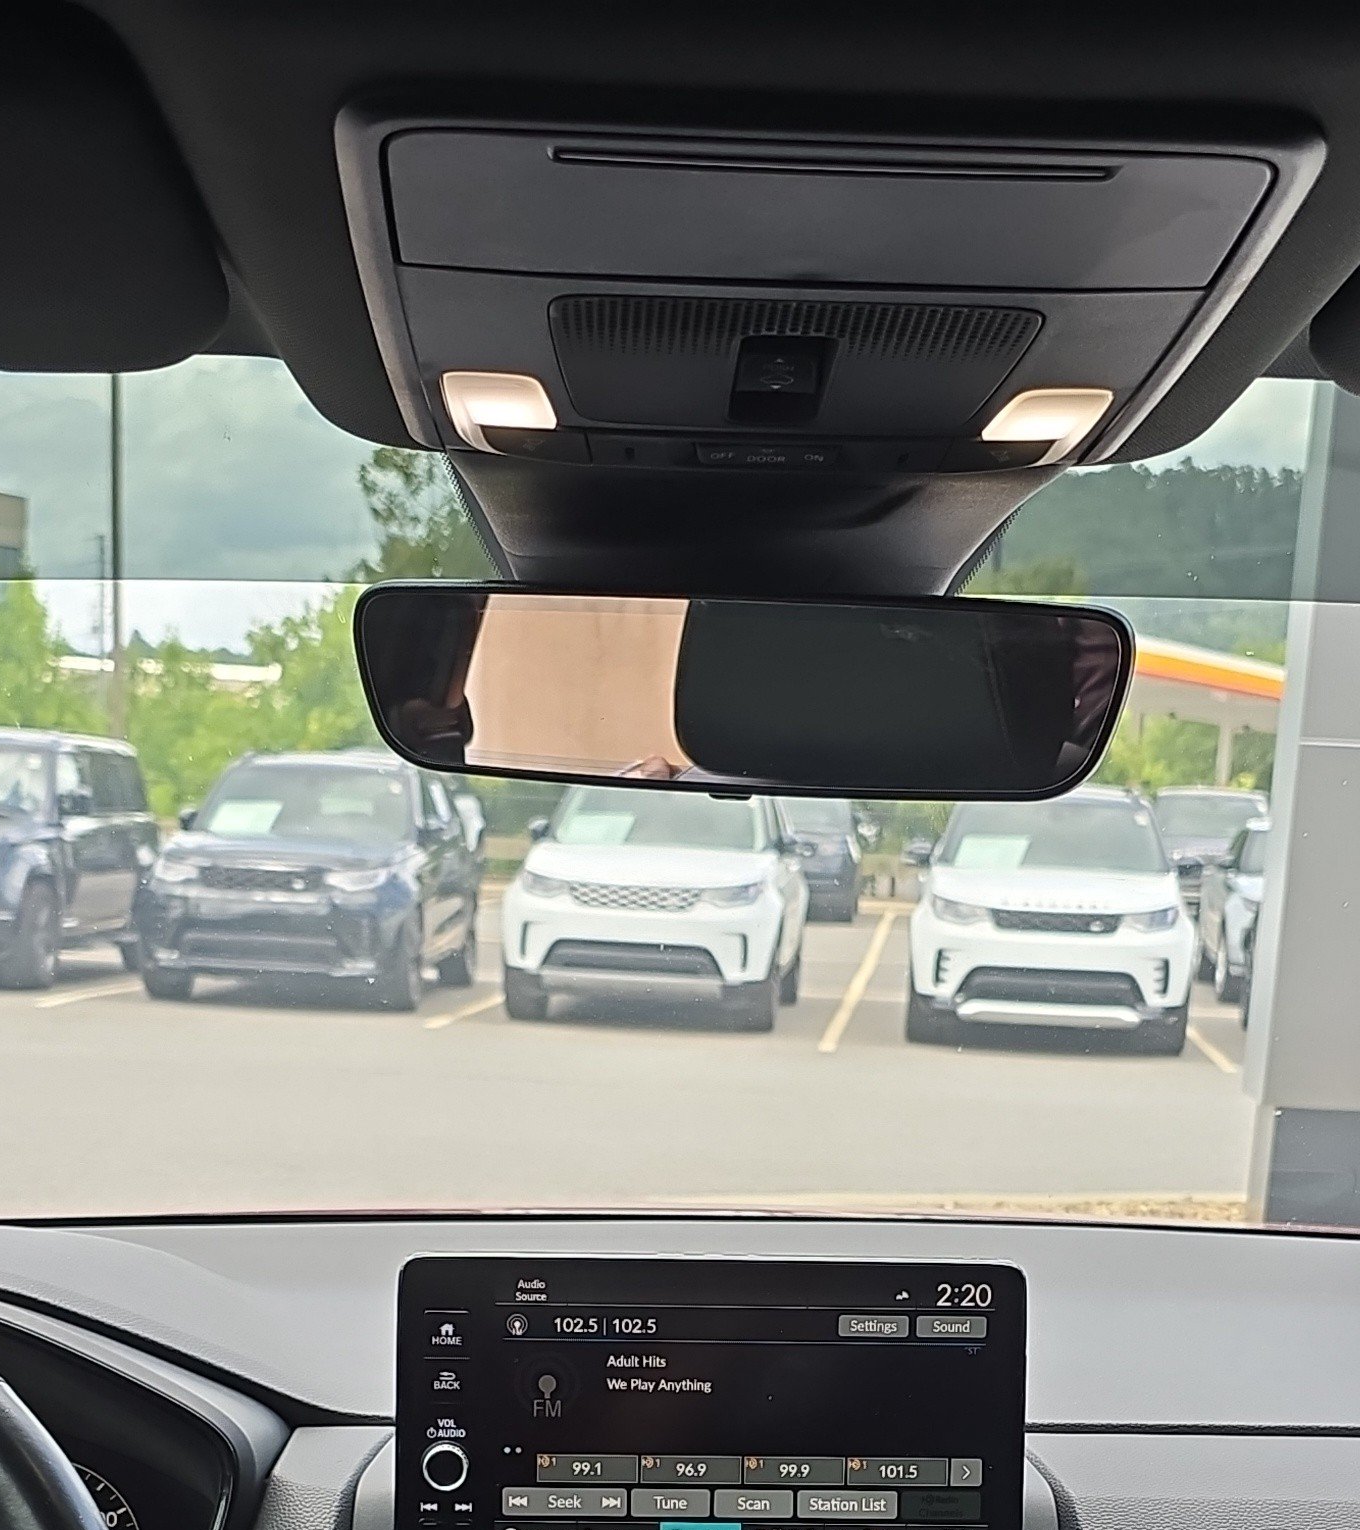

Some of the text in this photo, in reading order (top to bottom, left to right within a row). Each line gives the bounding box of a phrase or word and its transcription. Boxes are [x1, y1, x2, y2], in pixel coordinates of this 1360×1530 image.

[746, 455, 787, 463] DOOR
[803, 454, 824, 462] ON
[517, 1279, 546, 1290] Audio
[515, 1291, 547, 1302] Source
[936, 1283, 993, 1307] 2:20
[554, 1317, 657, 1334] 102.5 102.5
[850, 1319, 898, 1334] Settings
[932, 1320, 971, 1333] Sound
[431, 1336, 462, 1346] HOME
[606, 1355, 667, 1368] Adult Hits
[433, 1380, 461, 1390] BACK
[606, 1379, 713, 1394] We Play Anything
[532, 1400, 562, 1418] FM
[437, 1418, 457, 1428] VOL
[437, 1428, 467, 1438] AUDIO
[572, 1461, 603, 1476] 99.1
[675, 1462, 707, 1477] 96.9
[779, 1463, 810, 1478] 99.9
[878, 1464, 919, 1479] 101.5
[547, 1494, 582, 1509] Seek
[653, 1496, 689, 1510] Tune
[737, 1497, 771, 1511] Scan
[809, 1498, 887, 1512] Station List
